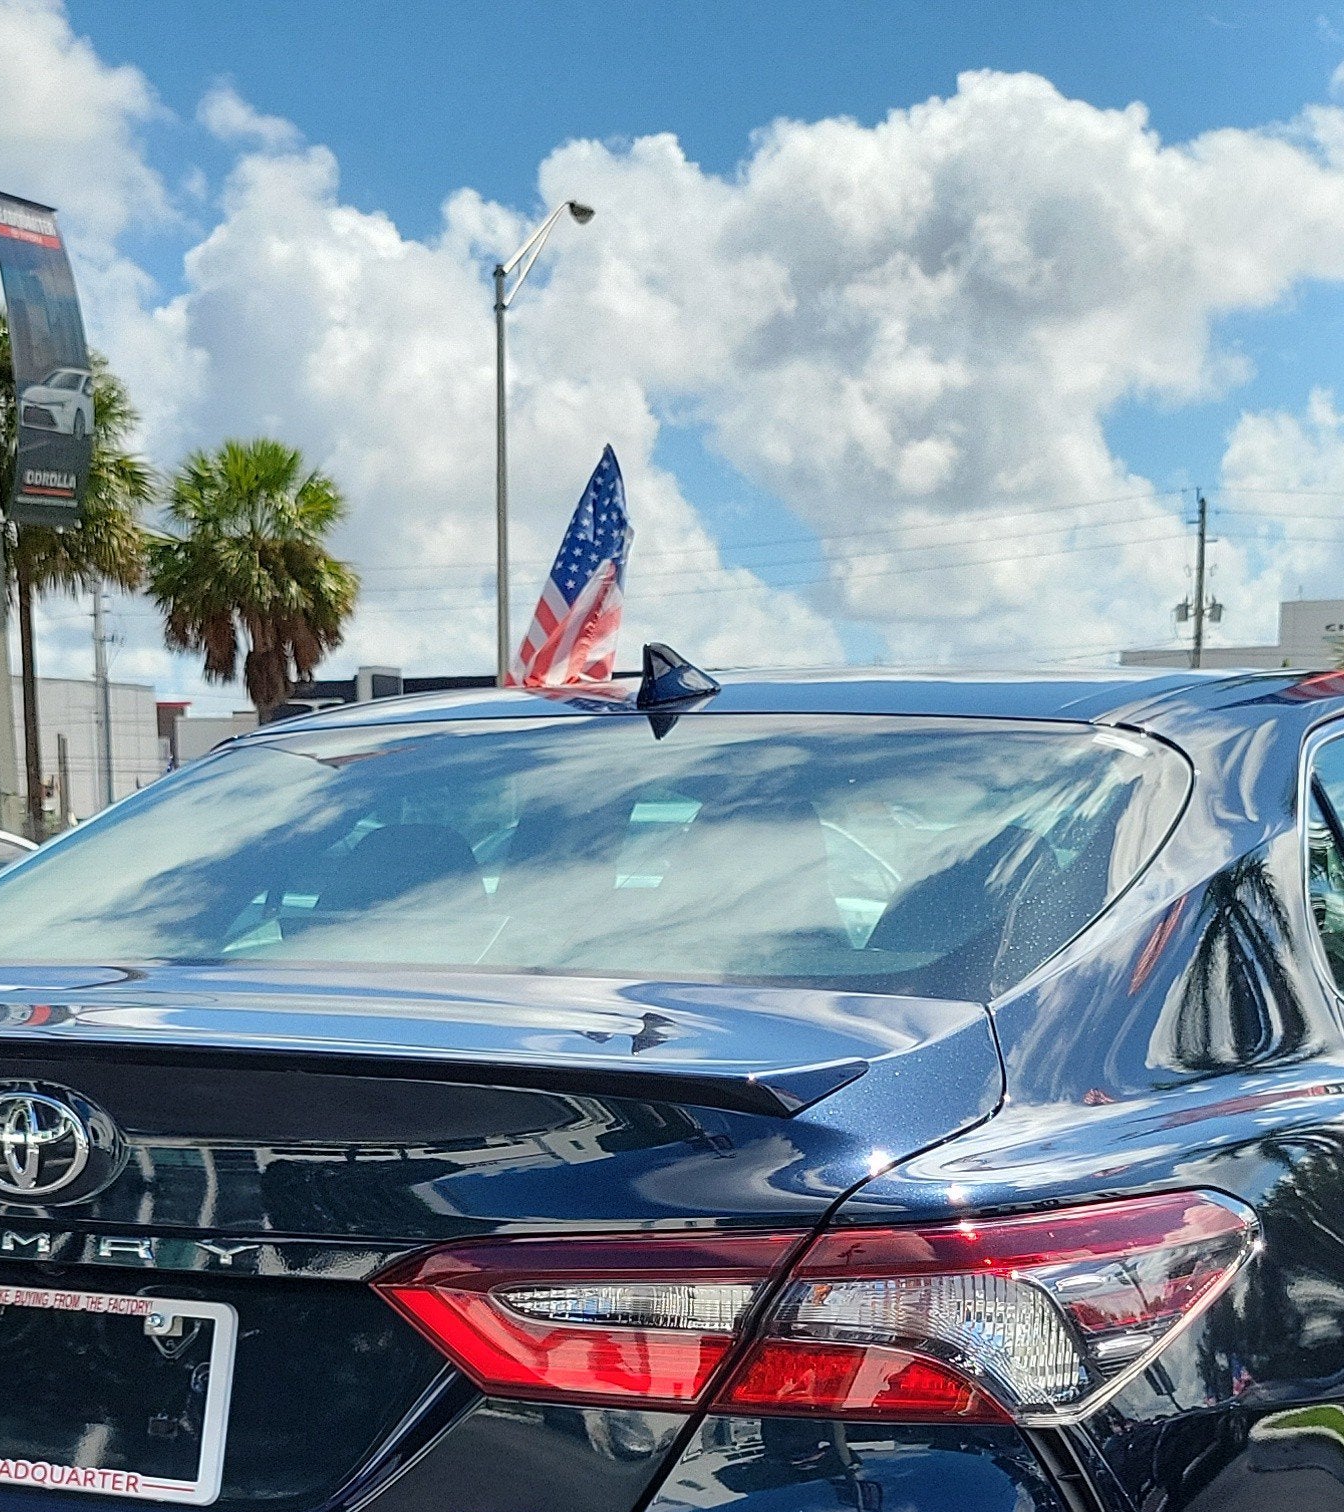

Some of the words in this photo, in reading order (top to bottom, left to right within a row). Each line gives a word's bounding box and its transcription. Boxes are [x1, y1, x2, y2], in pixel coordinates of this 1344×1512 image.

[14, 1290, 49, 1307] BUYING
[54, 1293, 81, 1310] FROM
[85, 1295, 104, 1311] THE
[108, 1297, 154, 1315] FACTORY!
